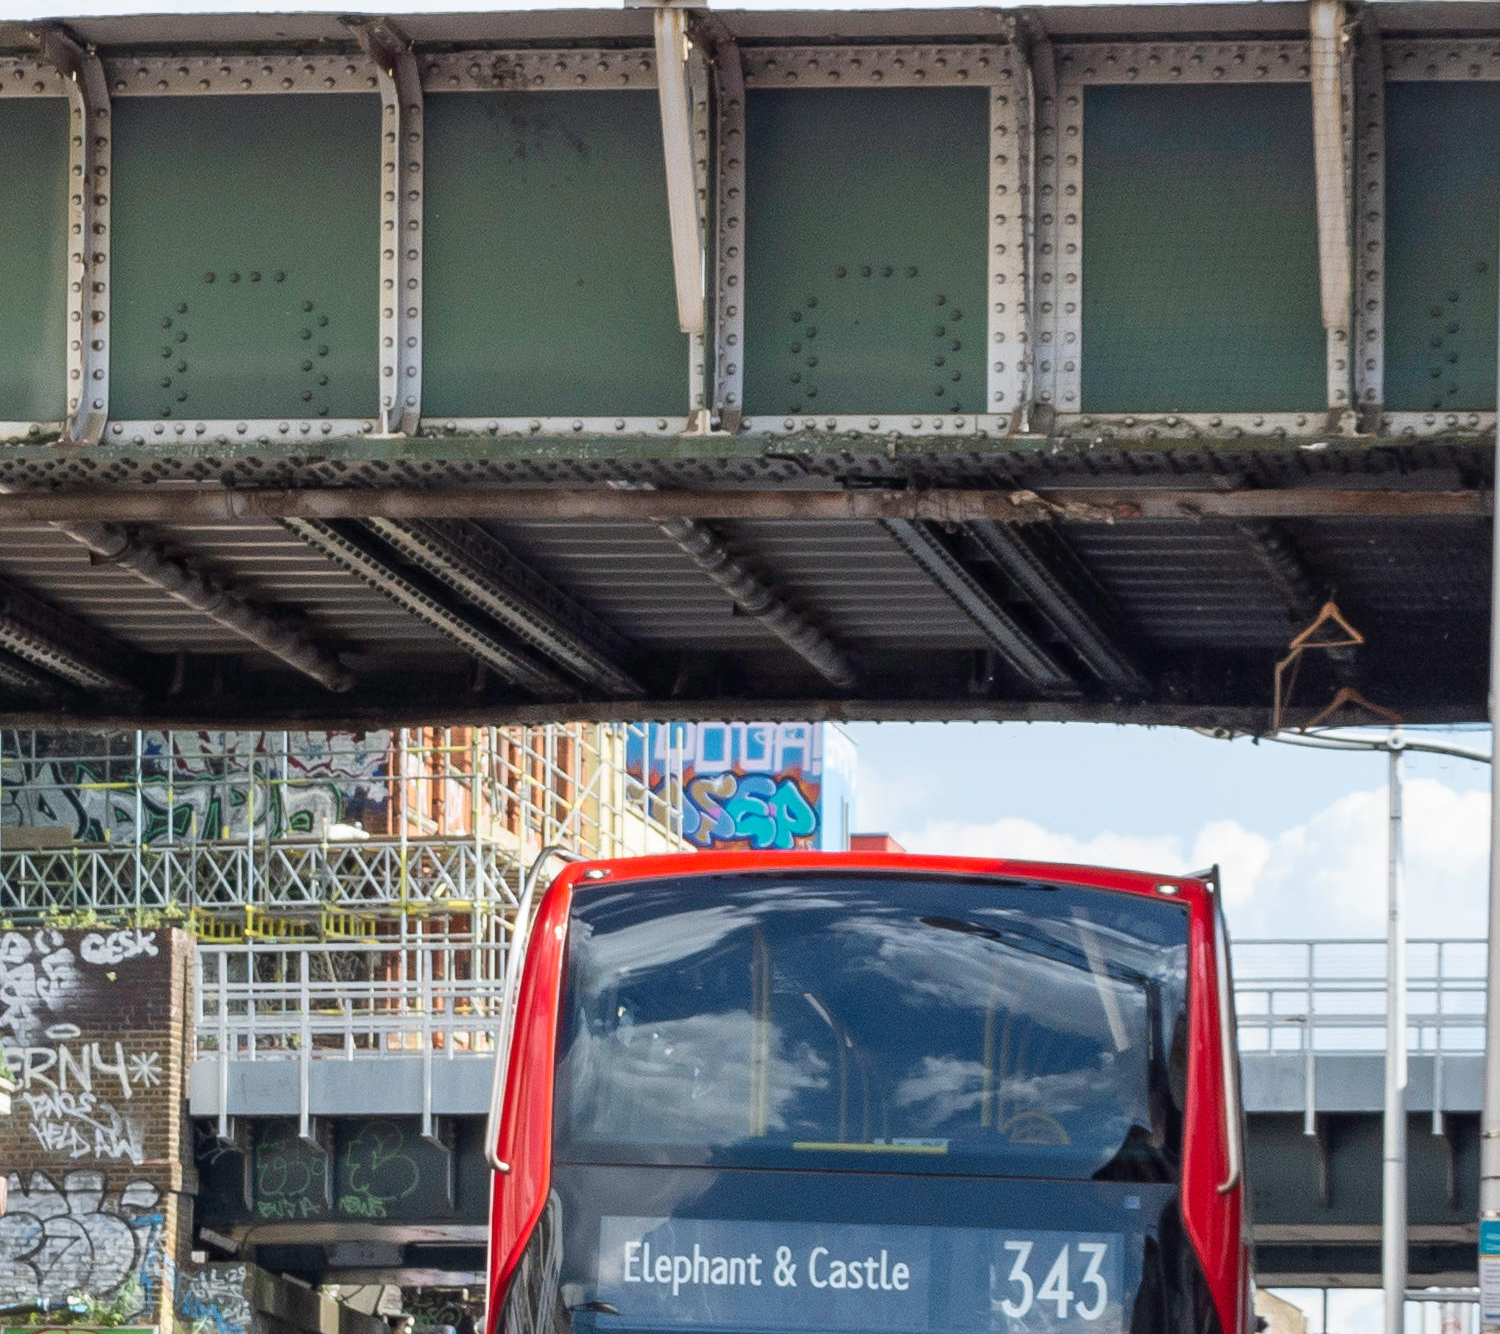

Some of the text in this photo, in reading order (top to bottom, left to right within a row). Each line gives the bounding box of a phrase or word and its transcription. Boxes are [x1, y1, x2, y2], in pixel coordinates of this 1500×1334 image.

[623, 1240, 911, 1296] Elephant & Castle
[1001, 1240, 1109, 1321] 343
